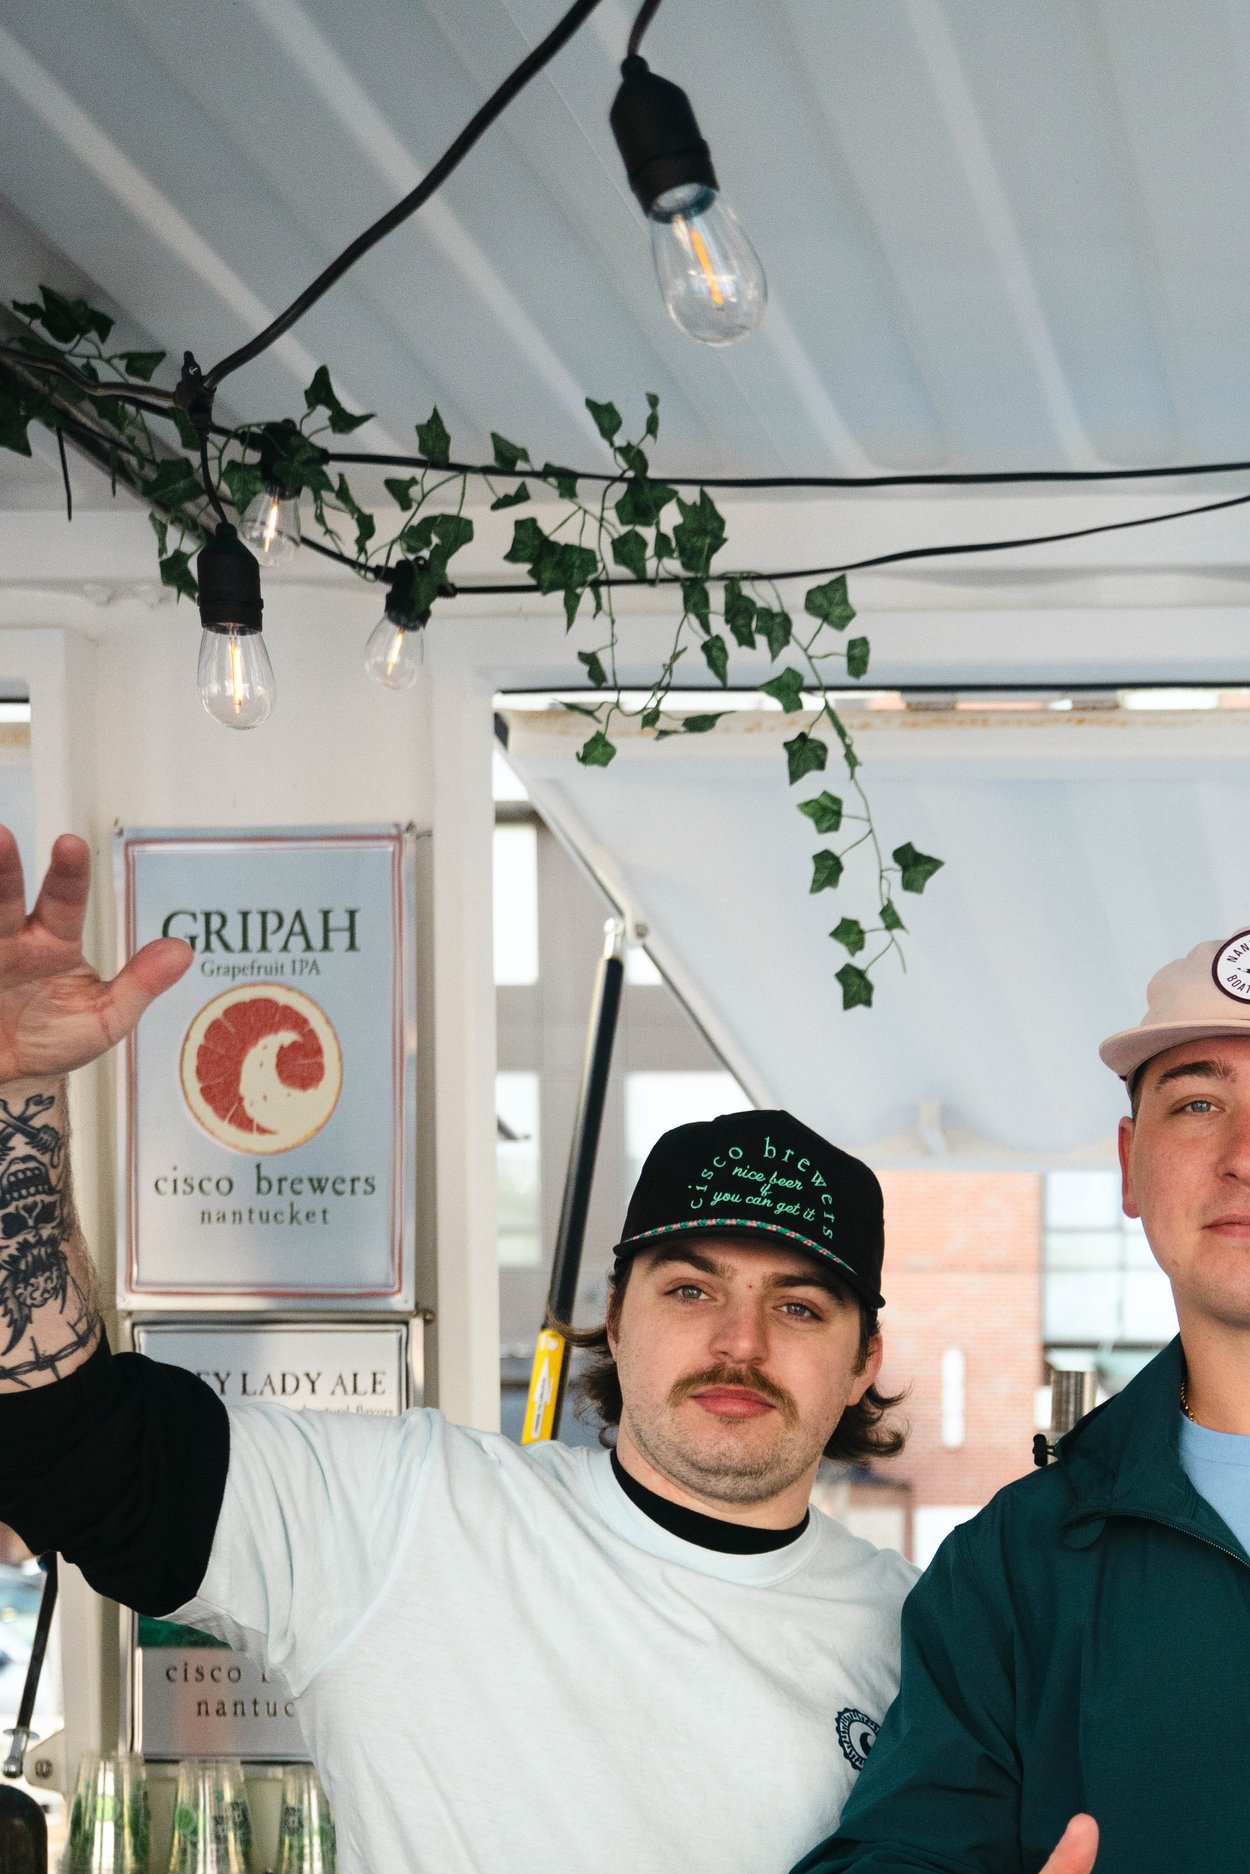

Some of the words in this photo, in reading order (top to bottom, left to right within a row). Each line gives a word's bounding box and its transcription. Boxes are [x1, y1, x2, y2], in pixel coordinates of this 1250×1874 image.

[161, 907, 361, 953] GRIPAH
[200, 957, 285, 981] Grapefruit
[292, 957, 321, 976] IPA
[154, 1166, 234, 1196] cisco
[255, 1162, 376, 1196] brewers
[688, 1146, 743, 1209] cisco
[762, 1136, 835, 1240] brewers
[732, 1164, 766, 1182] nice
[769, 1170, 804, 1191] beer
[760, 1183, 772, 1197] if
[200, 1201, 330, 1225] nantucket
[710, 1190, 742, 1206] you
[745, 1194, 773, 1208] can
[776, 1202, 800, 1216] get
[803, 1208, 816, 1223] it
[241, 1371, 322, 1396] LADY
[330, 1370, 387, 1396] ALE
[165, 1661, 242, 1683] cisco
[196, 1697, 296, 1717] nantuc
